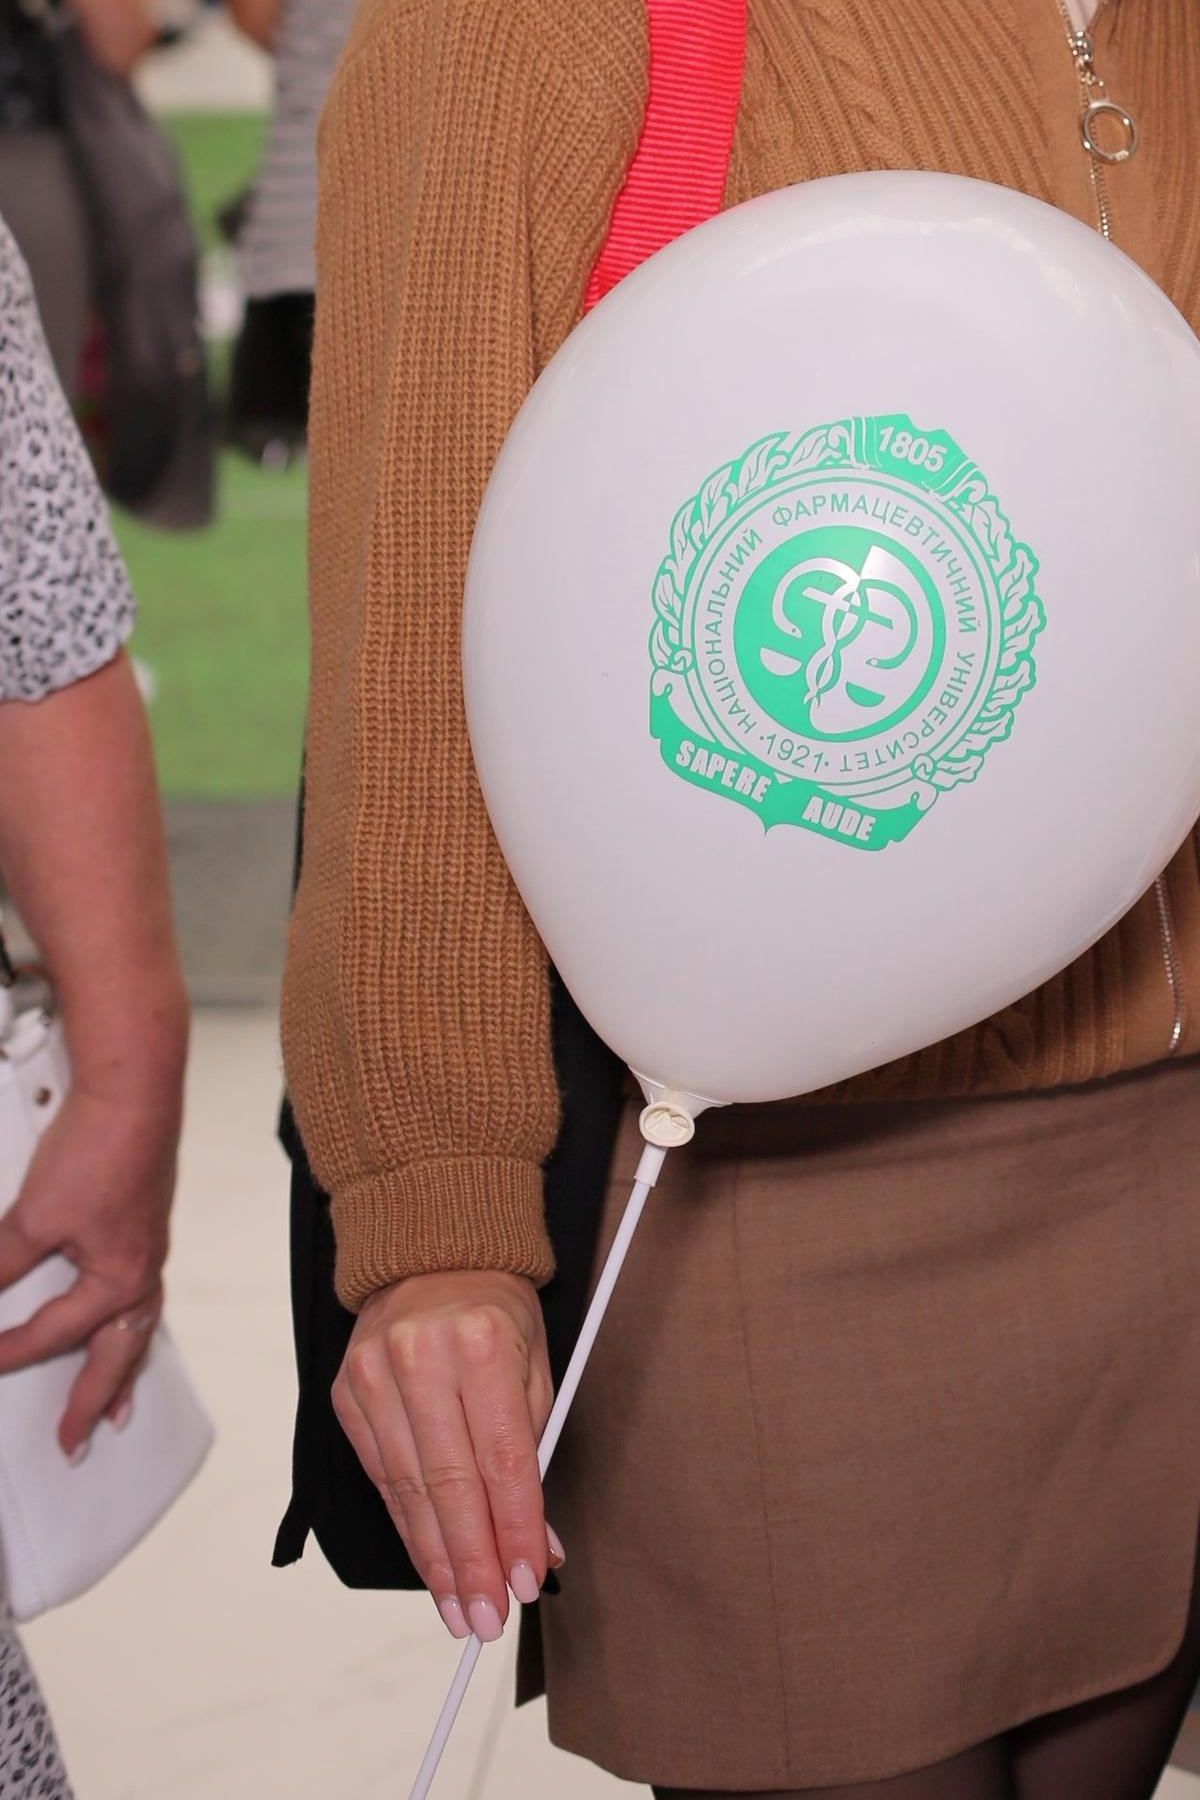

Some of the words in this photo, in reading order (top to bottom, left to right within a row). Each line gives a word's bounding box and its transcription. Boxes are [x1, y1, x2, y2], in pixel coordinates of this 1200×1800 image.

[879, 425, 948, 473] 1805
[771, 492, 981, 634] ФАРМАЦЕВТИЧНИЙ
[704, 527, 764, 735] НАЦІОНАЛЬНИЙ
[839, 651, 976, 773] УНІВЕРСИТЕТ
[675, 739, 773, 804] SAPERE
[801, 795, 877, 842] AUDE
